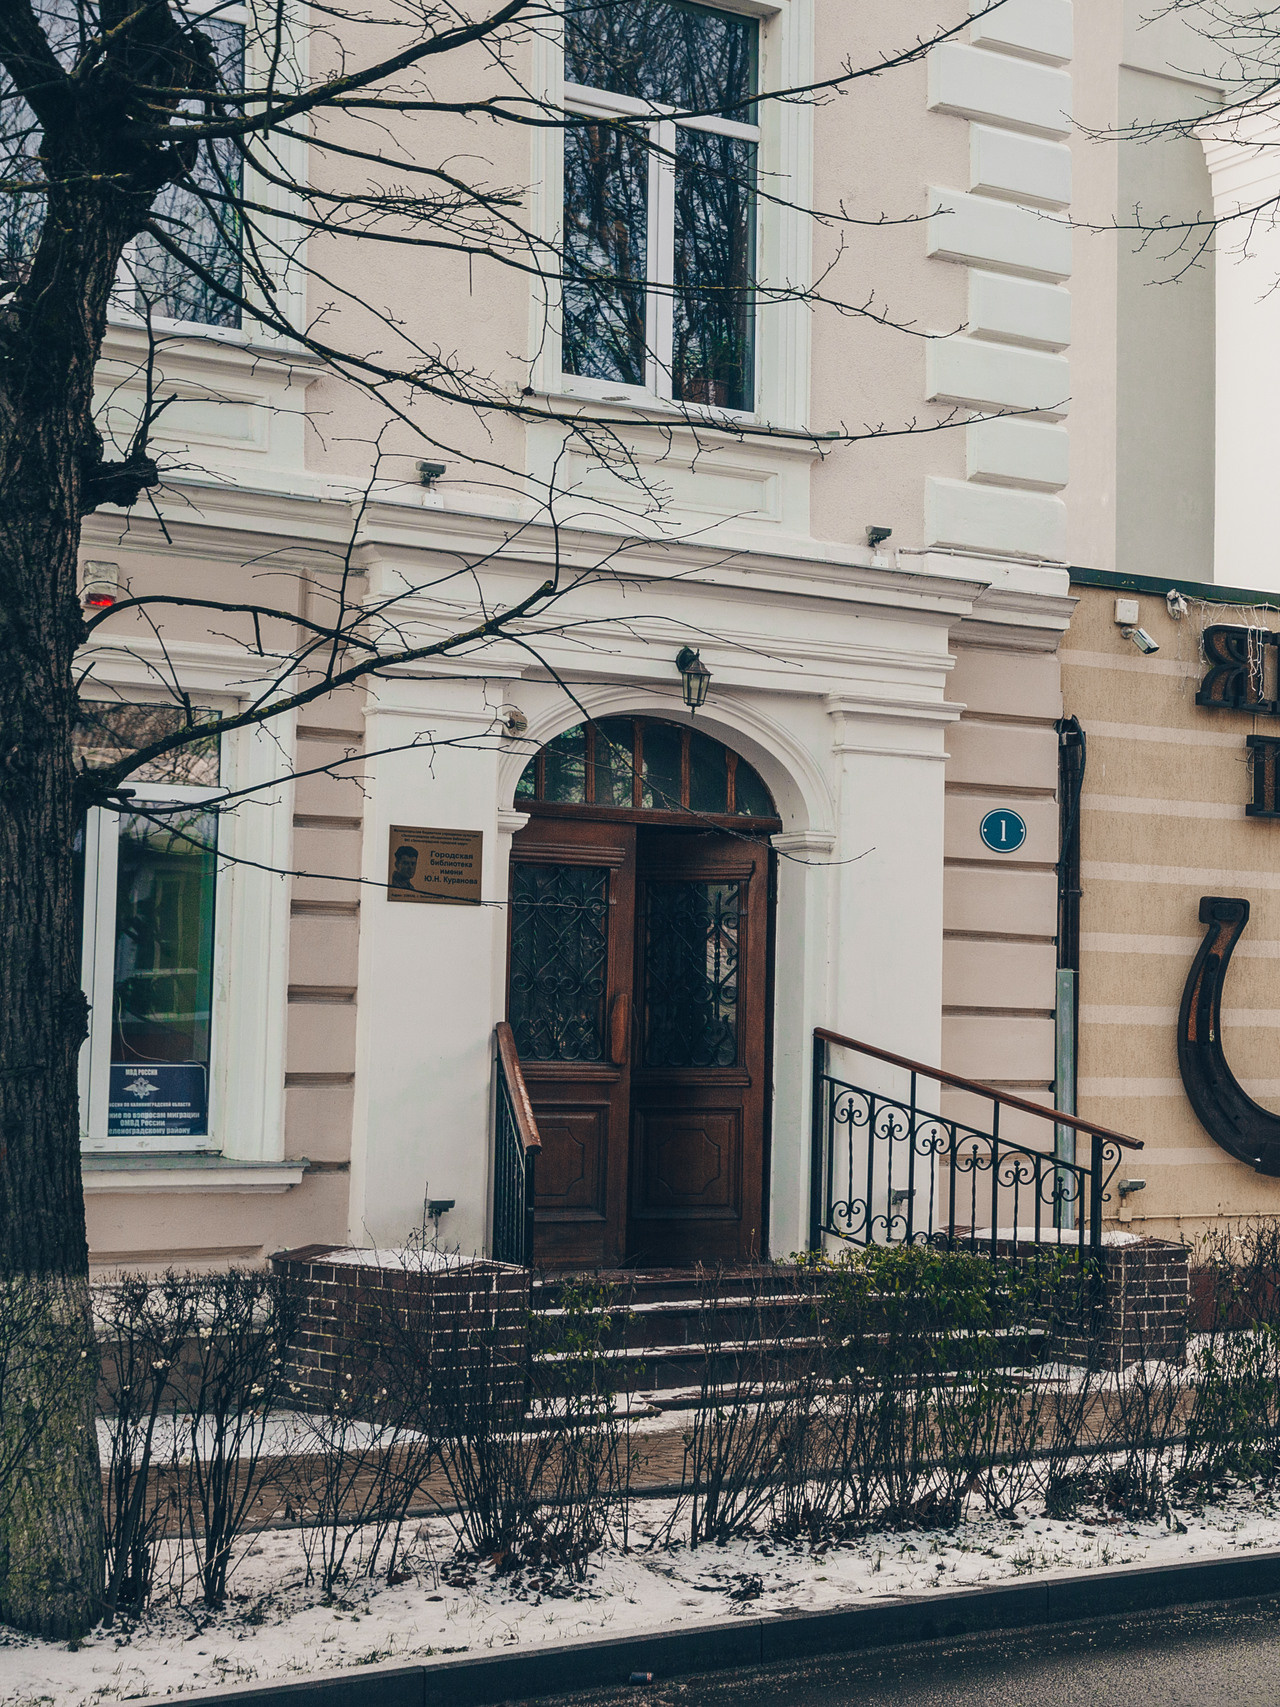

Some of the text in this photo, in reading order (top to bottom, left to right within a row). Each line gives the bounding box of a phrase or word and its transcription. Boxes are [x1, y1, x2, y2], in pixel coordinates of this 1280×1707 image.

[1000, 819, 1006, 841] 1
[430, 850, 473, 860] Городская
[430, 859, 473, 868] библиотека
[440, 868, 463, 876] имени
[424, 875, 478, 885] Ю.Н. Куранова
[166, 1127, 191, 1135] району
